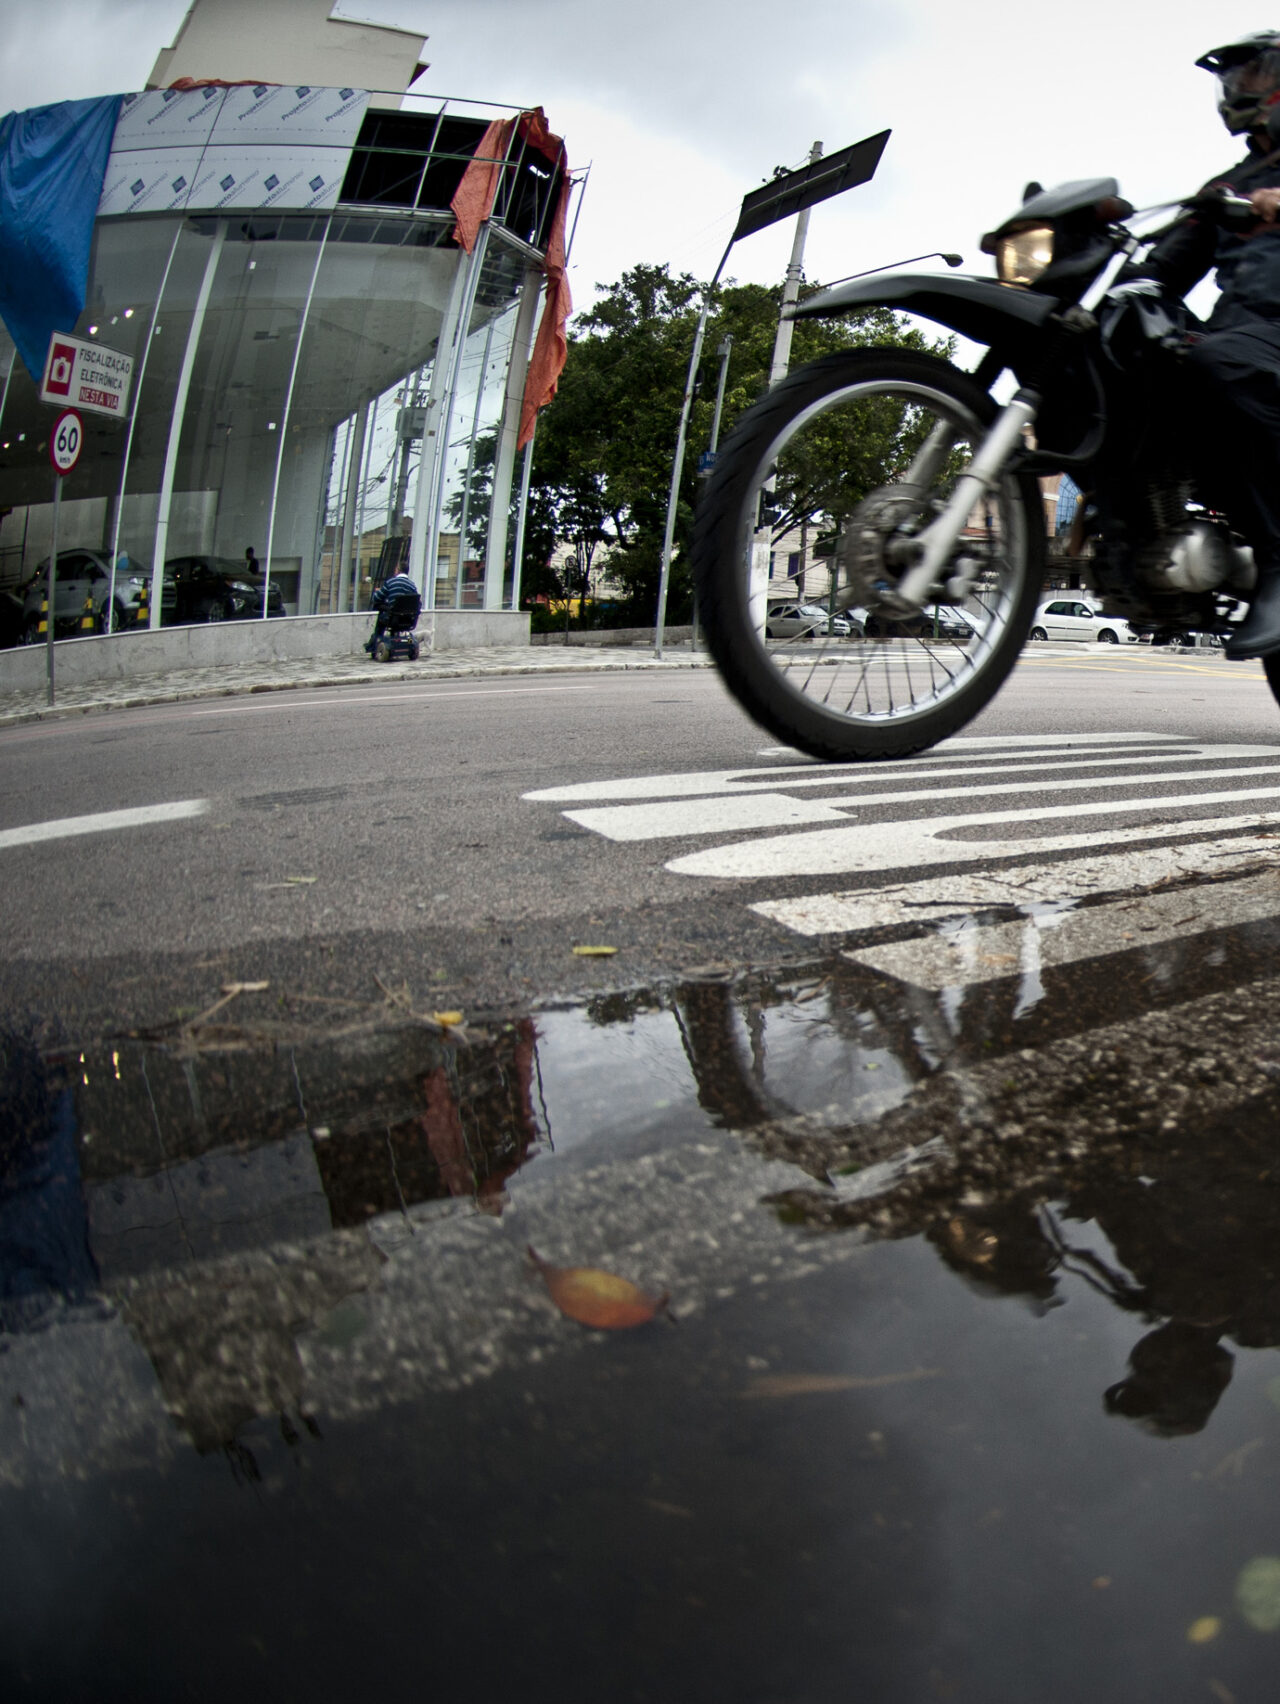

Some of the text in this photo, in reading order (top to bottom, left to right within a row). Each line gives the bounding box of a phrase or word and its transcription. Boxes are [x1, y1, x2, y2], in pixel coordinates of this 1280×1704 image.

[80, 348, 130, 373] FISCALIZAÇÃO
[80, 368, 122, 390] ELETRÔNICA
[80, 387, 118, 409] NESTA VIA
[58, 426, 78, 453] 60
